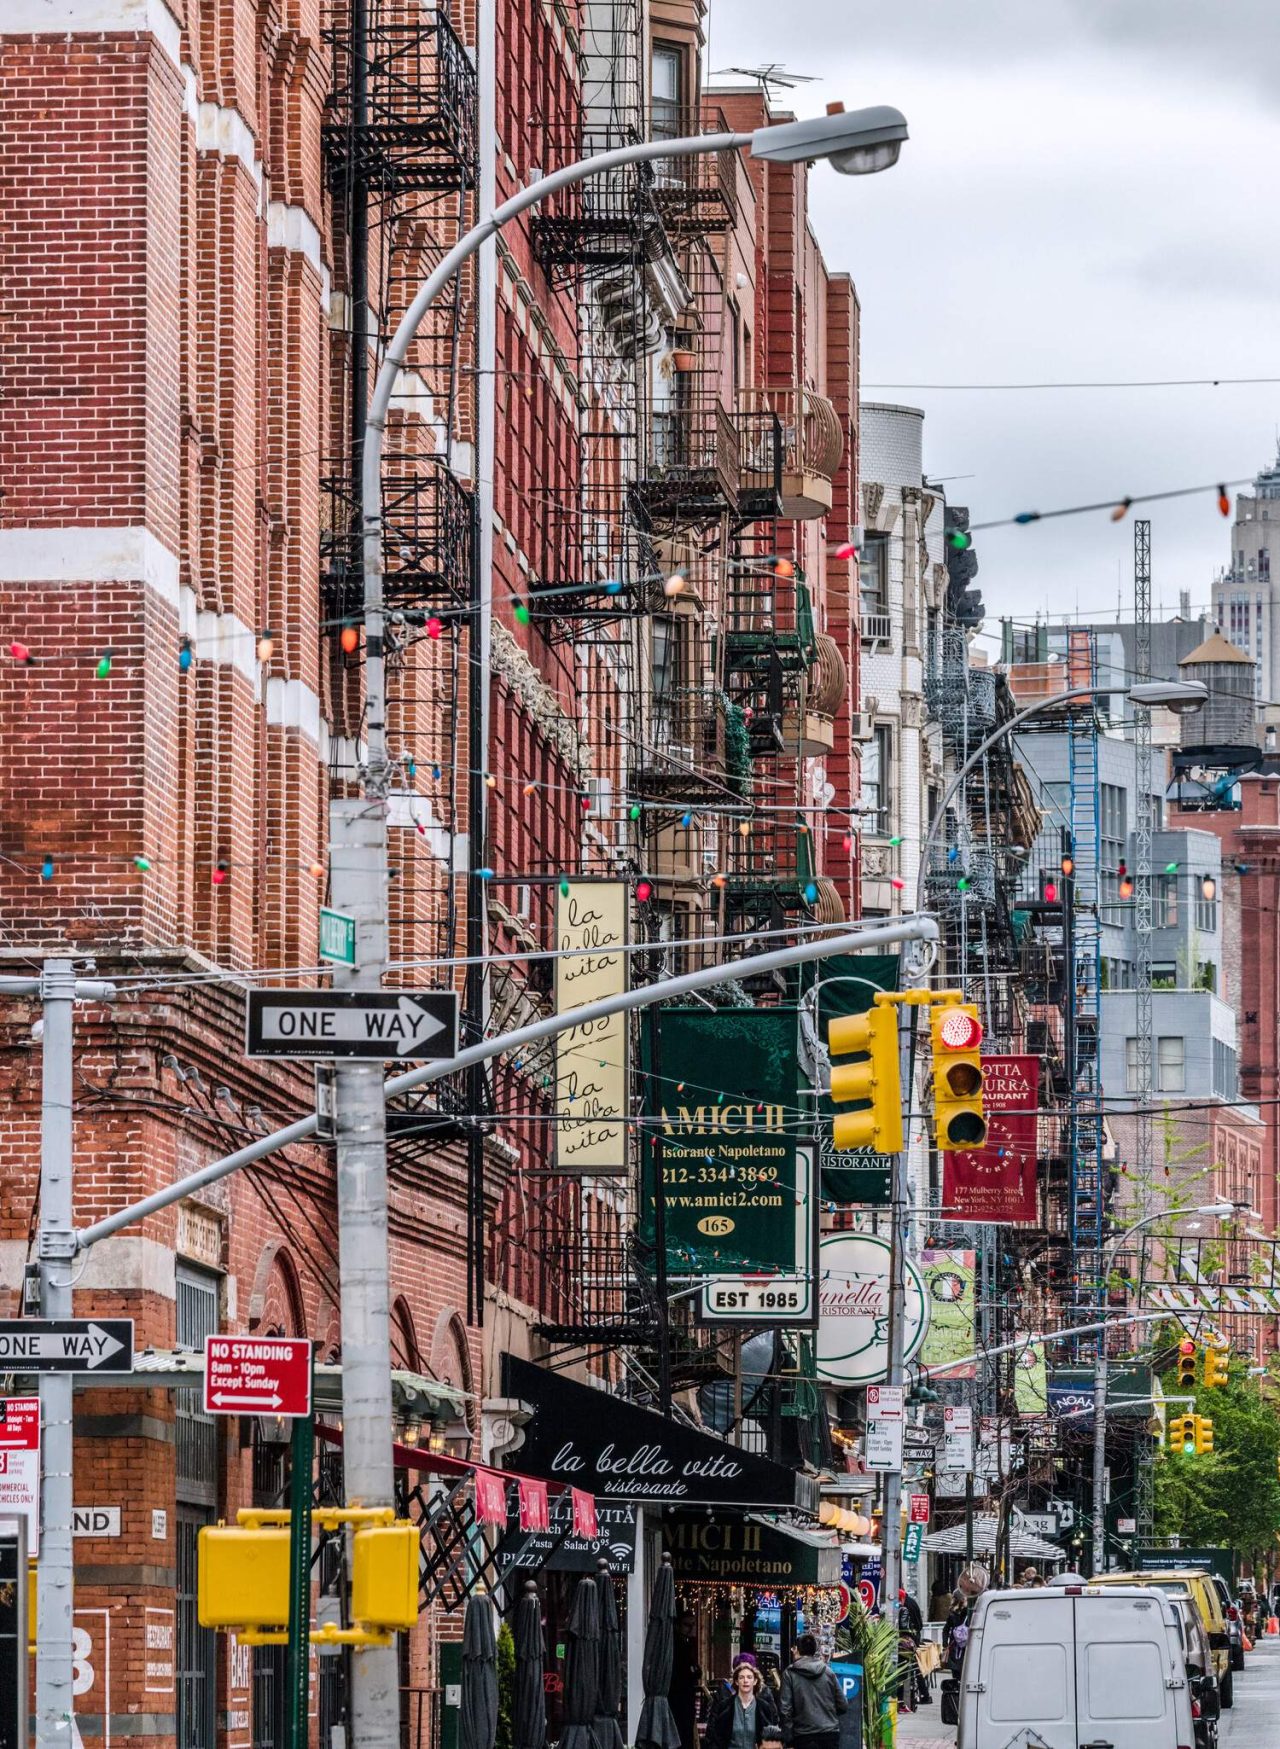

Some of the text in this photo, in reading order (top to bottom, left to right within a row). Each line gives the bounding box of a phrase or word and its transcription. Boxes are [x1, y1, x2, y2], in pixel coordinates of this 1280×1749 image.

[568, 898, 604, 927] la
[562, 924, 620, 959] bella
[564, 954, 618, 981] vita
[279, 1011, 426, 1038] ONE WAY
[568, 1071, 604, 1099] la
[560, 1096, 620, 1133] bella
[661, 1105, 786, 1135] AMICI II
[565, 1128, 619, 1154] vita
[651, 1145, 786, 1160] istorante Napoletano
[704, 1220, 728, 1232] 165
[716, 1292, 798, 1308] EST 1985
[0, 1337, 109, 1356] ONE WAY
[211, 1343, 293, 1361] NO STANDING
[211, 1361, 232, 1373] 8am
[240, 1362, 265, 1376] 10pm
[211, 1375, 279, 1391] Except Sunday
[15, 1402, 37, 1411] STANDING
[551, 1441, 742, 1478] la bella vita
[604, 1478, 689, 1496] ristorante
[564, 1541, 589, 1551] Salad
[906, 1525, 919, 1552] PARK
[698, 1555, 792, 1576] Napoletano
[843, 1678, 855, 1693] P
